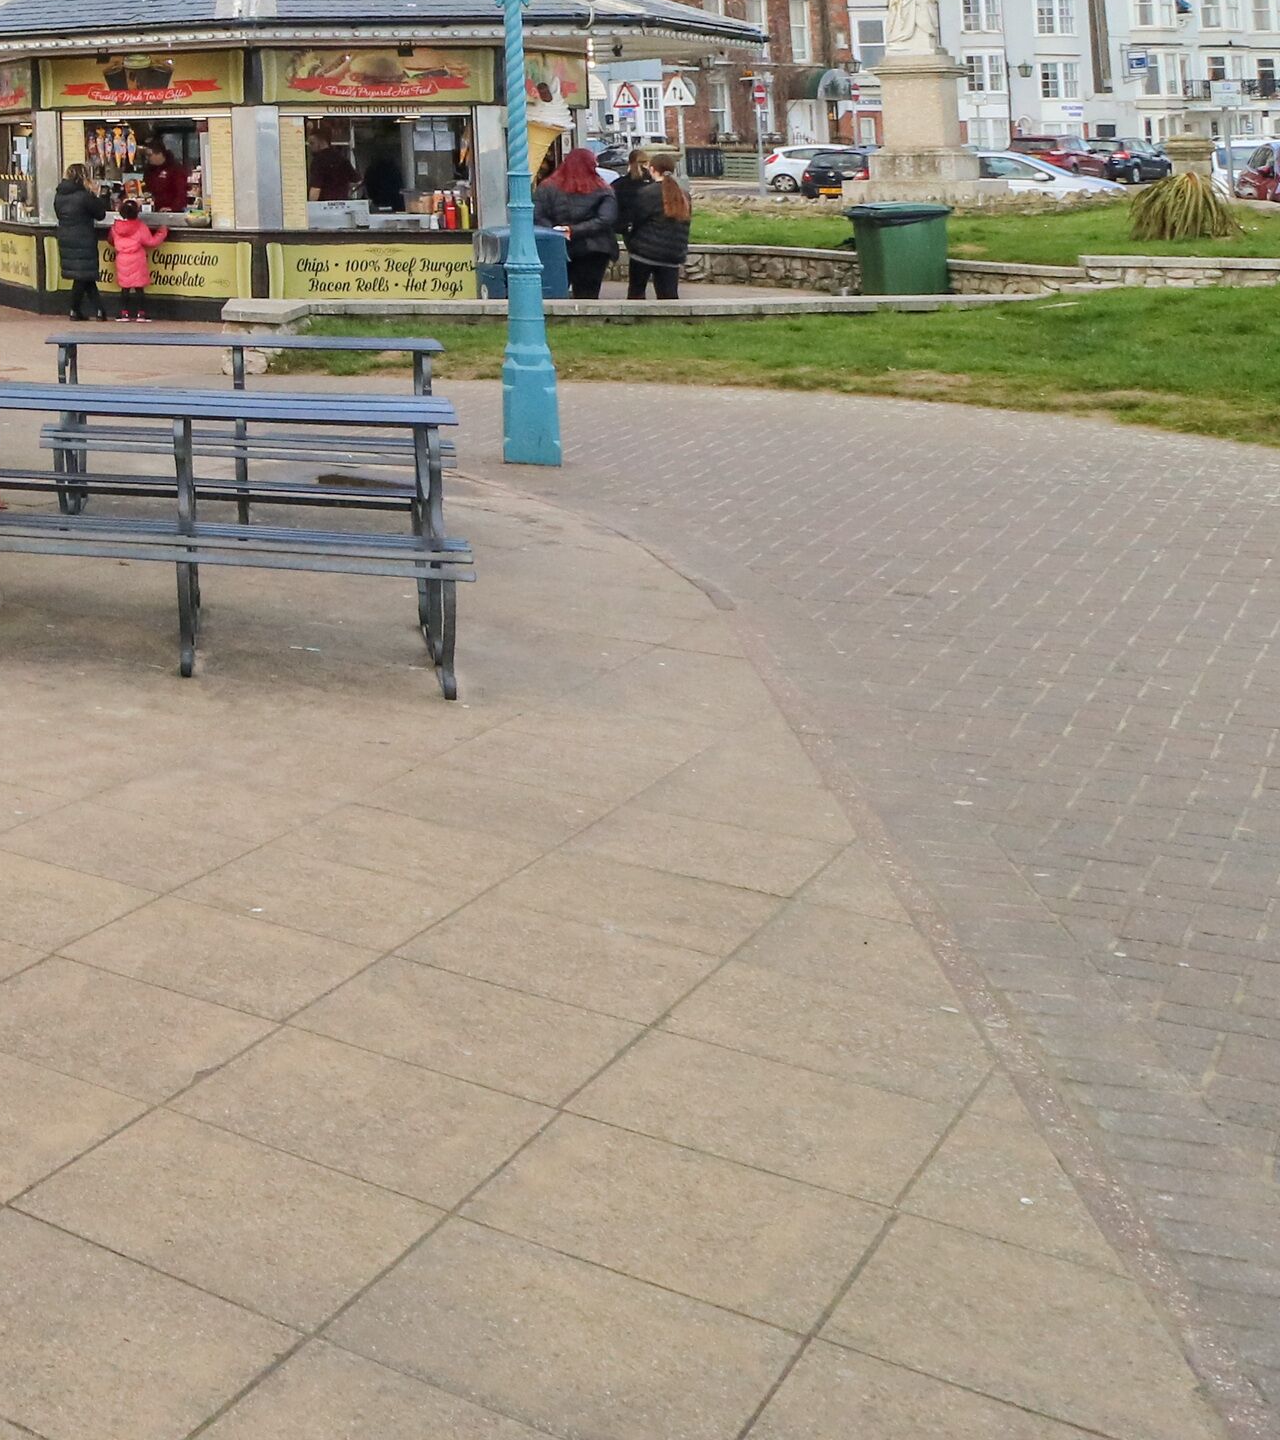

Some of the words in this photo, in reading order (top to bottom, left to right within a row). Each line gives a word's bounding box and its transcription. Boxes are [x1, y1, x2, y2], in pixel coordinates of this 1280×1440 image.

[392, 86, 409, 97] Hot
[410, 84, 432, 95] Food
[152, 248, 219, 271] Cappuccino
[296, 257, 330, 277] Chips
[345, 258, 381, 273] 100%
[384, 258, 416, 278] Beef
[419, 258, 474, 278] Burgers
[149, 271, 205, 287] Chocolate
[308, 277, 351, 293] Bacon
[356, 277, 390, 293] Rolls
[402, 277, 427, 293] Hot
[431, 277, 464, 298] Dogs
